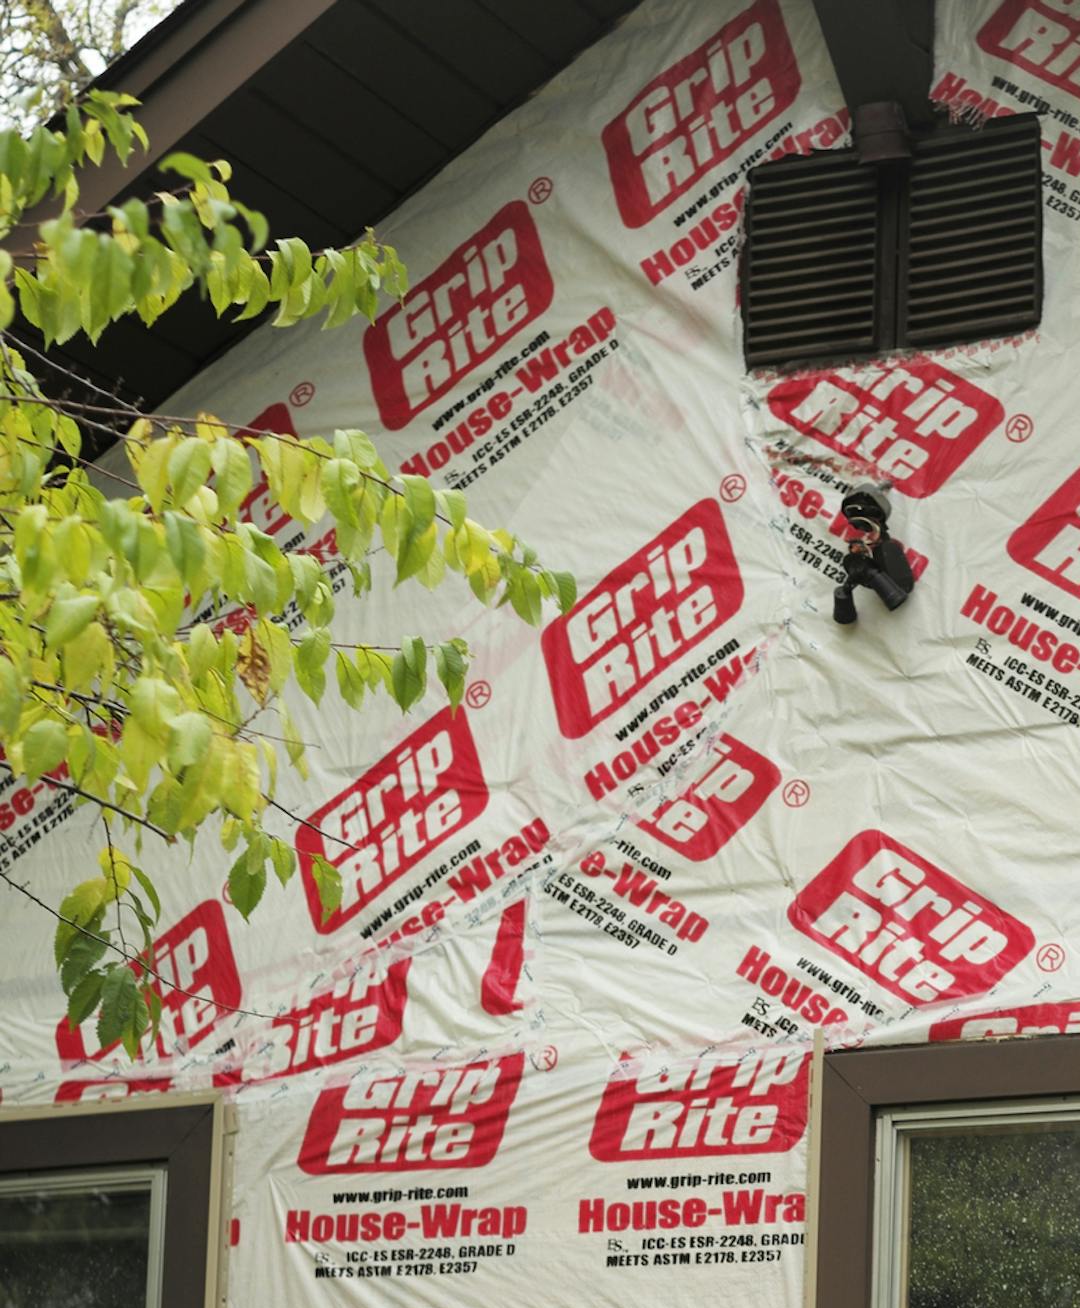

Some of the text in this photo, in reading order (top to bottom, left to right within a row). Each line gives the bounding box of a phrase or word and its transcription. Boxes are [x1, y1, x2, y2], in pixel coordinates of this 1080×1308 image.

[621, 21, 767, 157] Grip
[638, 76, 776, 206] Rite
[673, 122, 792, 227] www.grip-rite.com
[386, 227, 520, 360] Grip
[690, 256, 731, 292] MEETS
[401, 282, 529, 409] Rite
[432, 330, 550, 431] www.grip-rite.com
[471, 426, 511, 463] ICC-ES
[567, 345, 610, 383] GRADE
[608, 337, 620, 351] D
[489, 434, 522, 467] ASTM
[558, 373, 594, 408] E2357
[789, 379, 930, 480] Rite
[566, 526, 707, 663] Grip
[582, 584, 717, 715] Rite
[614, 637, 739, 741] www.grip-rite.com
[964, 651, 1006, 682] MEETS
[1004, 675, 1042, 704] ASTM
[1002, 655, 1046, 687] ICC-ES
[319, 730, 454, 861] Grip
[332, 786, 462, 914] Rite
[358, 839, 482, 940] www.grip-rite.com
[603, 921, 640, 950] E2357
[627, 918, 669, 951] GRADE
[666, 943, 678, 957] D
[810, 892, 955, 1003] Rite
[853, 849, 1008, 964] Grip
[325, 1114, 476, 1166] Rite
[620, 1097, 779, 1151] Rite
[284, 1203, 528, 1245] House-Wrap
[332, 1186, 468, 1205] www.grip-rite.com
[577, 1189, 806, 1234] House-Wra
[627, 1171, 771, 1191] www.grip-rite.com
[345, 1249, 389, 1264] ICC-ES
[458, 1244, 503, 1259] GRADE
[506, 1243, 516, 1256] D
[355, 1264, 393, 1279] ASTM
[438, 1261, 478, 1275] E2357
[606, 1249, 782, 1268] MEETS ASTM E2357
[641, 1236, 687, 1251] ICC-ES
